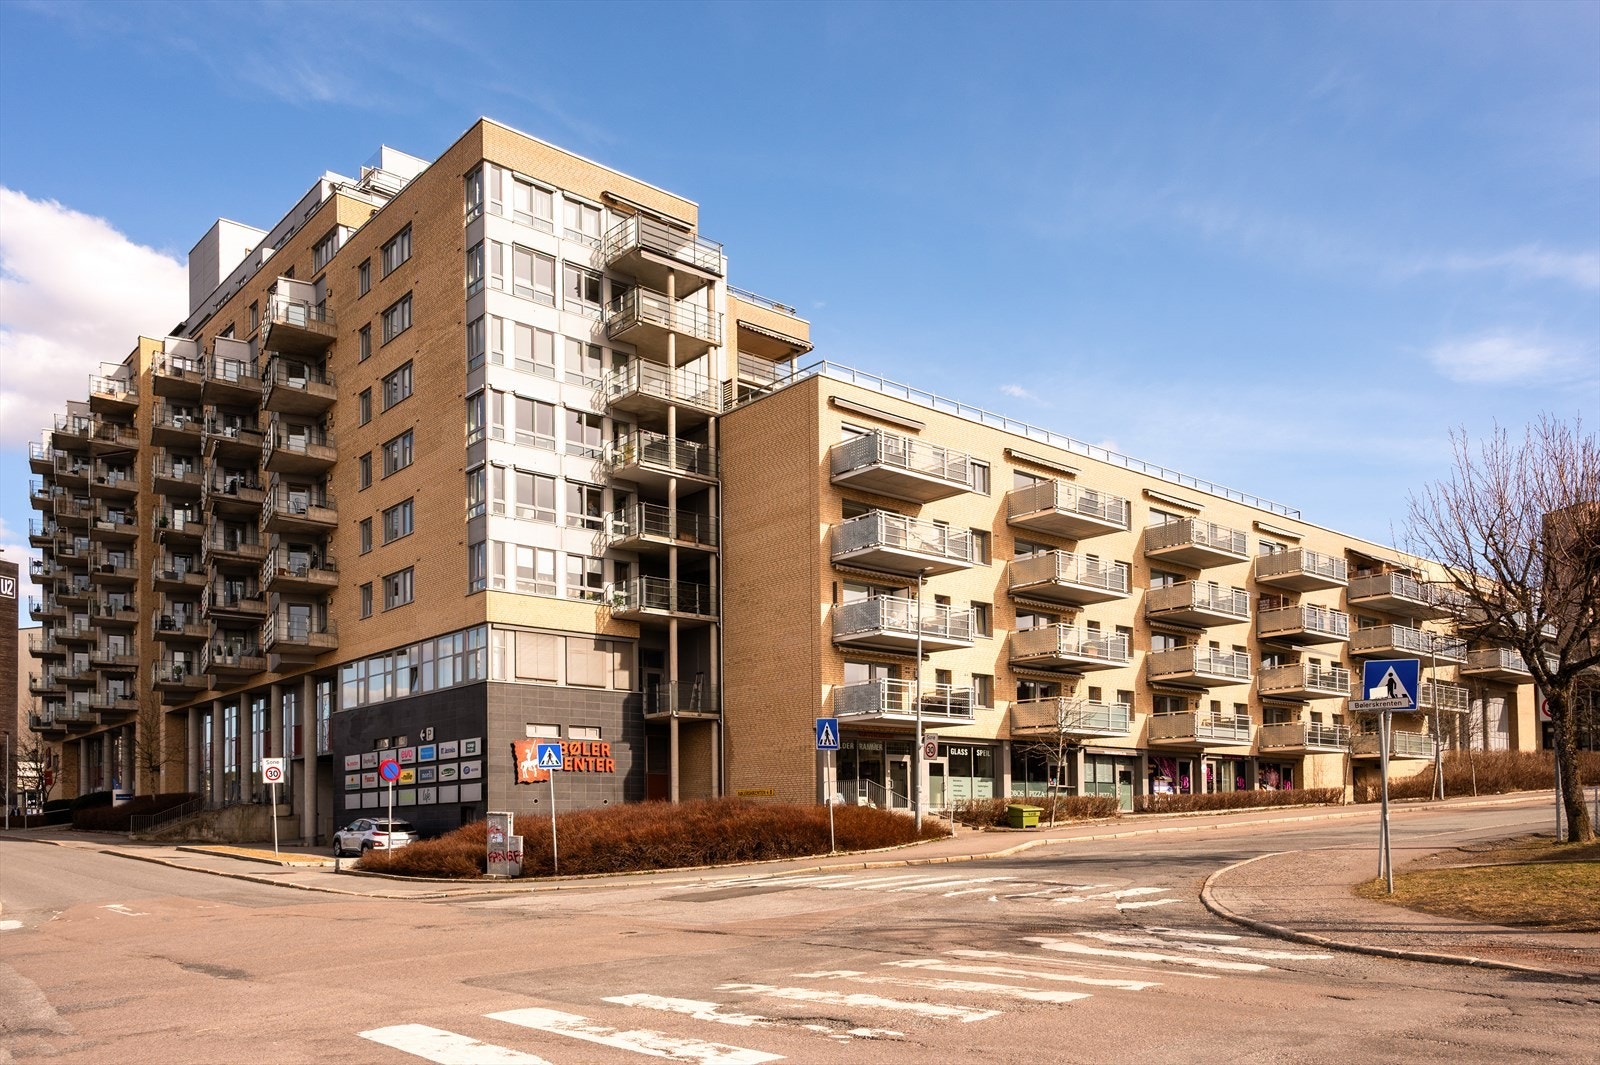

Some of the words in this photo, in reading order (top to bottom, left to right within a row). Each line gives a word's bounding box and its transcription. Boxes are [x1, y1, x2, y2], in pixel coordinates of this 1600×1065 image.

[1, 579, 13, 596] U2
[559, 741, 610, 757] BØLER
[950, 748, 968, 756] GLASS
[976, 749, 991, 757] SPEIL
[562, 757, 616, 773] ENTER
[268, 770, 279, 778] 30
